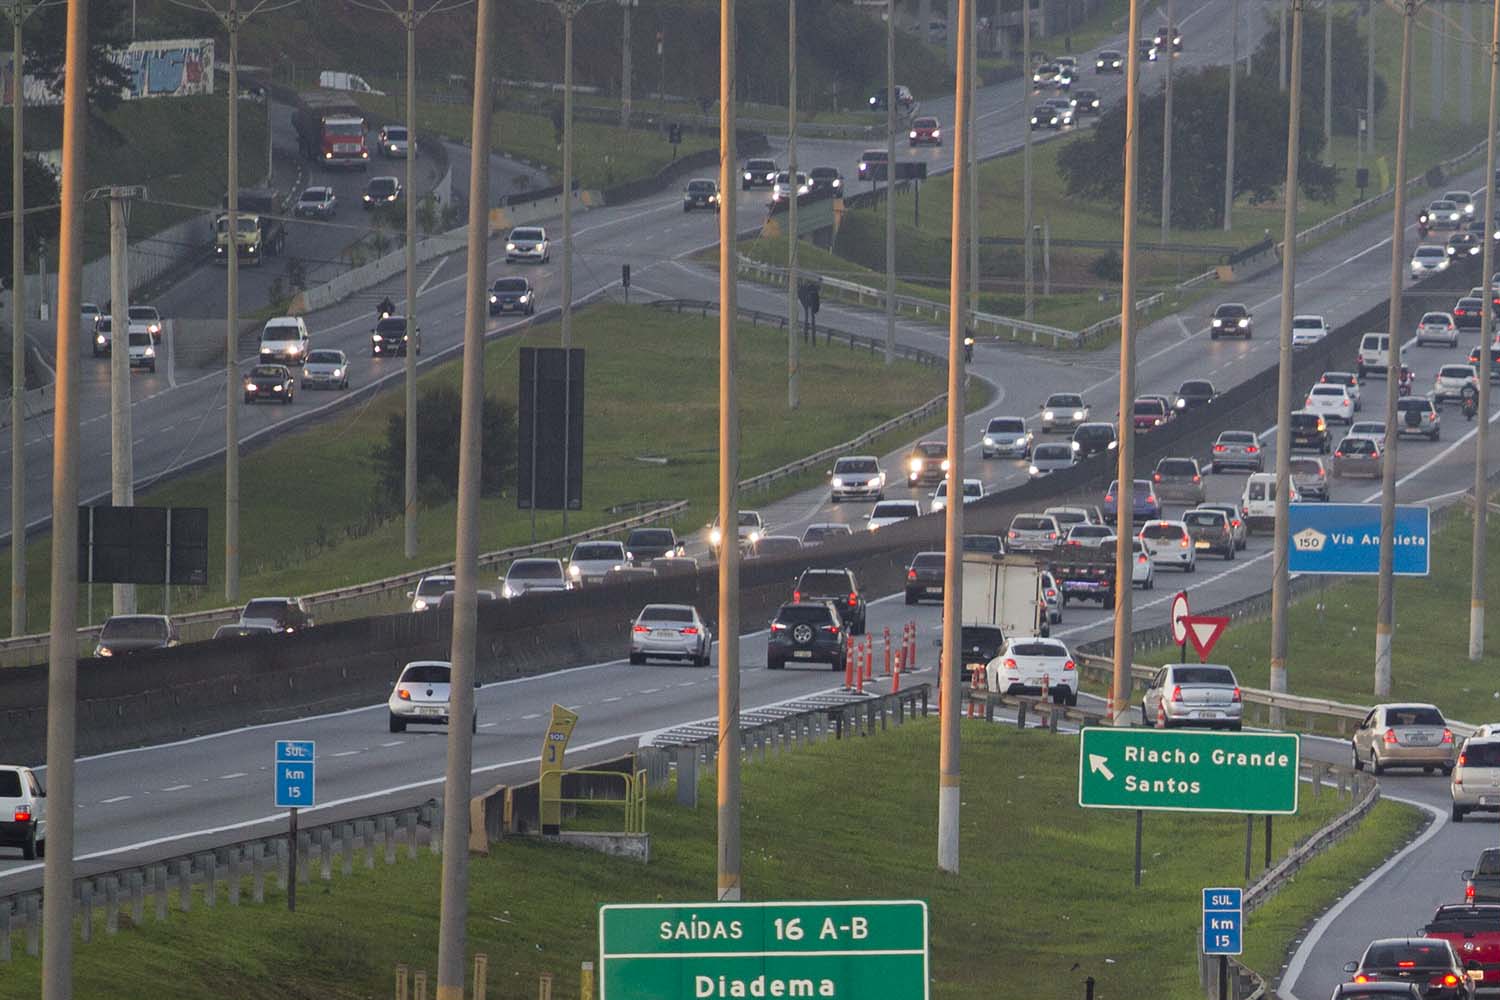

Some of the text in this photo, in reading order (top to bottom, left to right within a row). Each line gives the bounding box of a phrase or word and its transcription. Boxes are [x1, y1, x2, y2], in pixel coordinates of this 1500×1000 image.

[1300, 534, 1426, 548] 150 Via Anieta
[285, 747, 305, 757] SUL
[1124, 746, 1288, 767] Riacho Grande
[286, 768, 305, 780] km
[1124, 775, 1200, 794] Santos
[288, 786, 302, 798] 15
[1212, 895, 1232, 906] SUL
[660, 914, 869, 940] SAÍDAS 16 A-B
[1211, 918, 1234, 930] km
[1216, 935, 1230, 948] 15
[695, 975, 835, 998] Diadema
